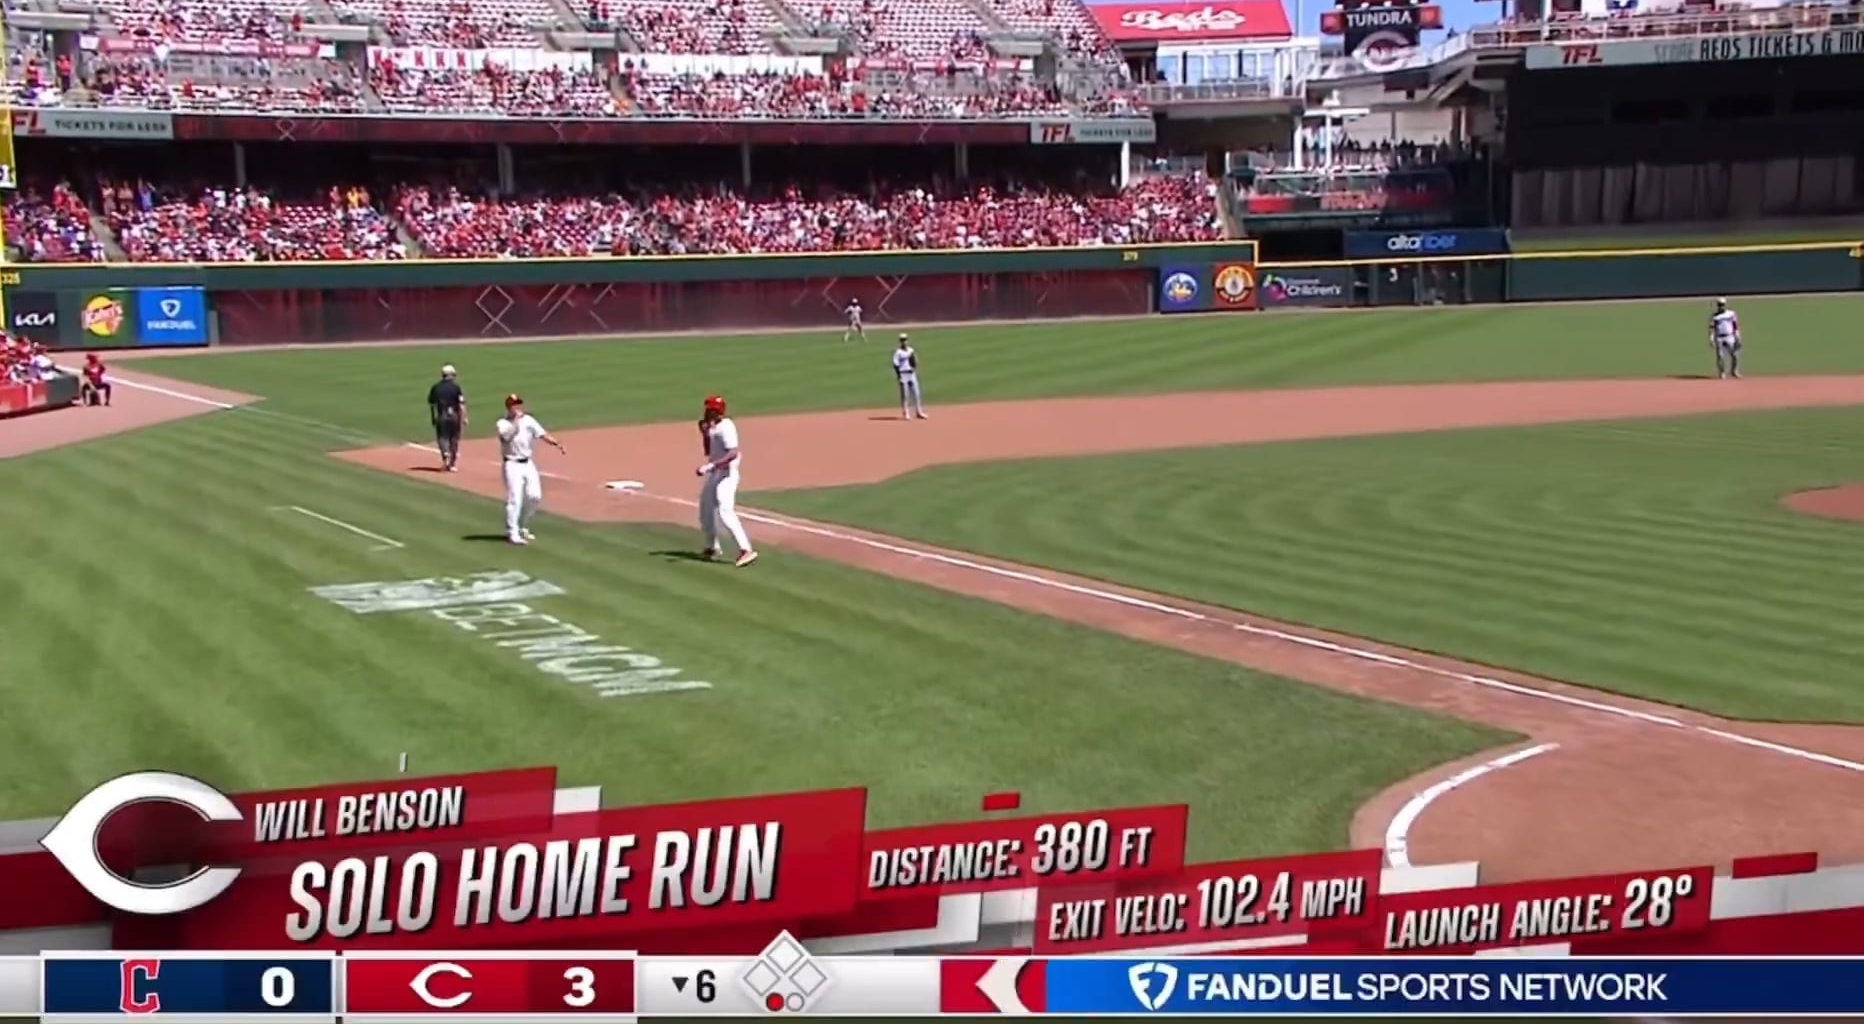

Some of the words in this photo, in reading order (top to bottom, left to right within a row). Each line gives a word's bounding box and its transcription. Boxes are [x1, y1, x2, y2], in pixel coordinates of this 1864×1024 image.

[1120, 6, 1246, 31] Reds
[1345, 11, 1412, 27] TUNDRA
[1560, 45, 1602, 64] TFL
[1749, 33, 1813, 58] TICKETS
[1040, 123, 1074, 142] TFL
